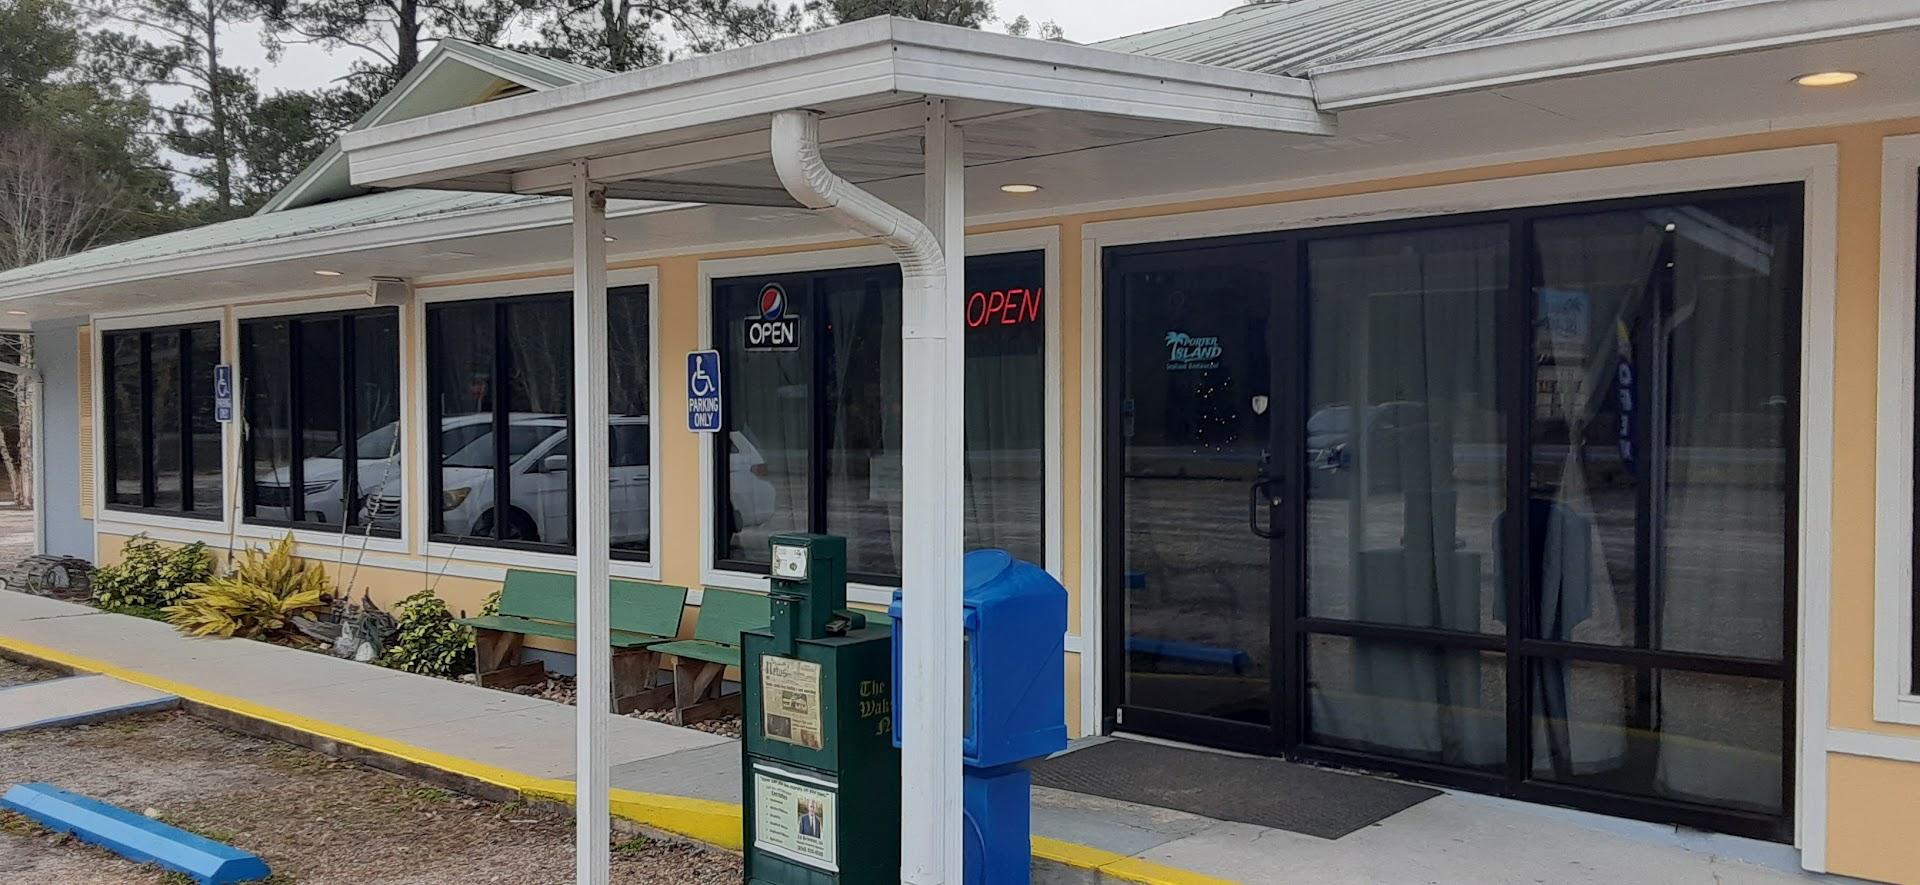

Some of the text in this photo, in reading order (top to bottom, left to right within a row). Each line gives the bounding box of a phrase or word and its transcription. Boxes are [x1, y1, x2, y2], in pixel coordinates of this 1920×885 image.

[966, 288, 1042, 328] OPEN
[749, 320, 794, 345] OPEN
[1183, 336, 1218, 346] PORTER
[1170, 345, 1222, 361] ISLAND
[689, 397, 719, 412] PARKING
[694, 412, 714, 428] ONLY
[859, 679, 886, 697] The
